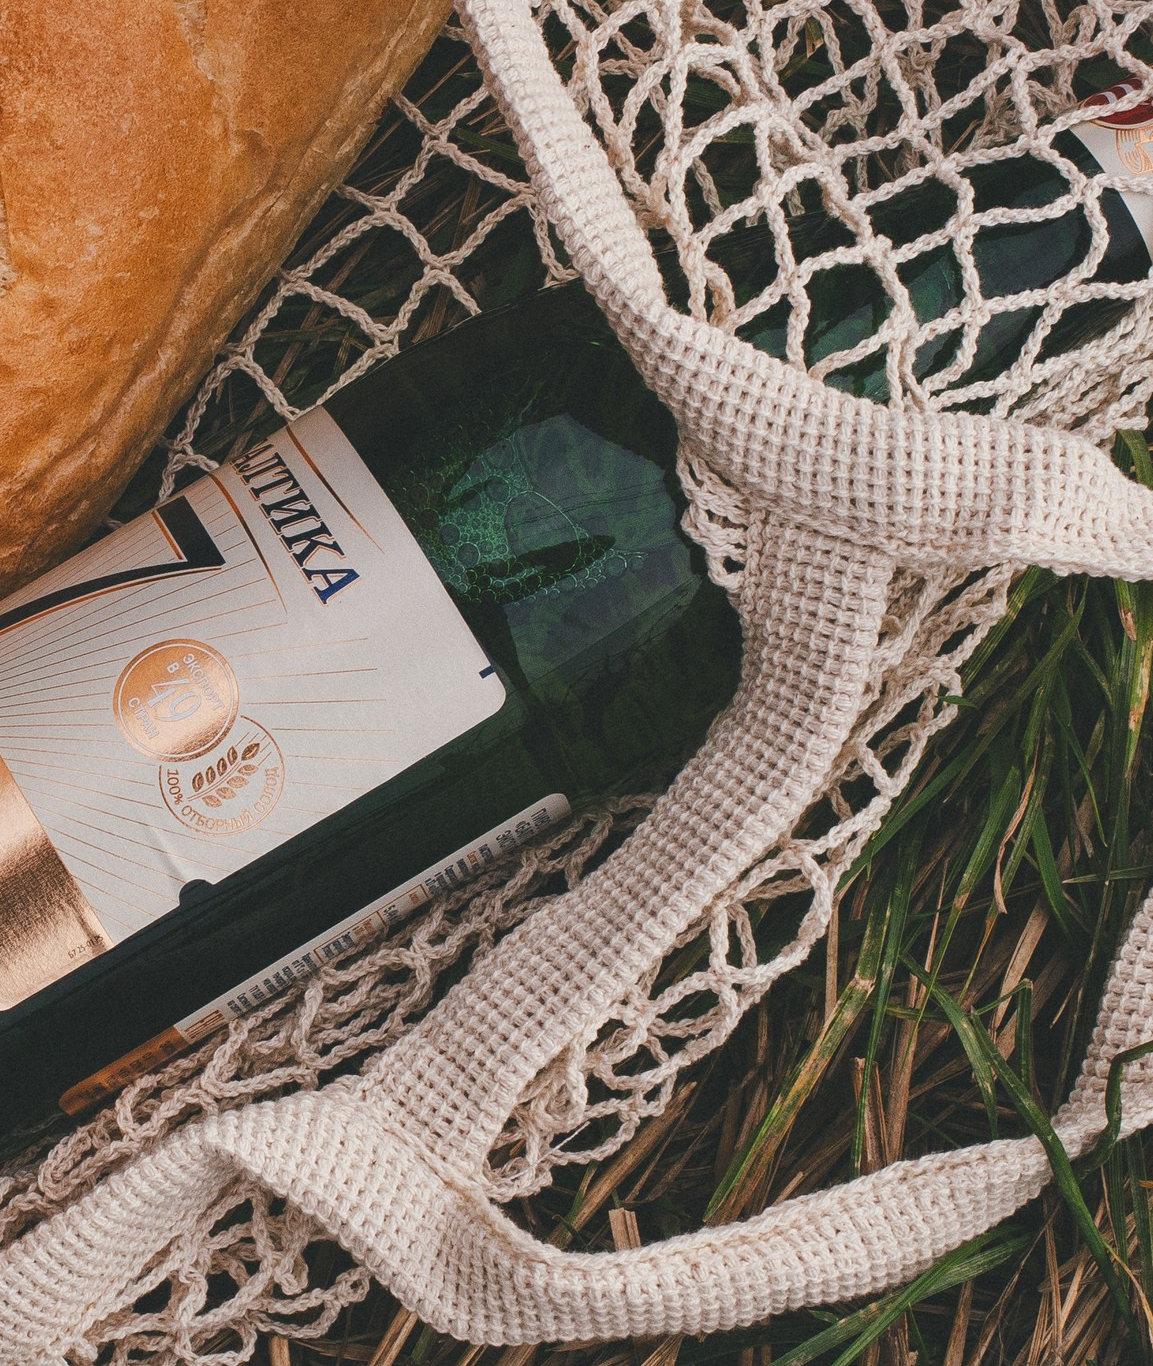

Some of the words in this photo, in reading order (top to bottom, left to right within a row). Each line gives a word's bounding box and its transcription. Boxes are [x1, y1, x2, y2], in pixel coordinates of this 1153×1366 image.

[167, 662, 180, 674] В
[183, 653, 225, 711] ЭКСПОРТ
[128, 697, 160, 740] СТРАН
[148, 678, 202, 724] 49
[167, 769, 184, 805] 100%
[181, 805, 254, 831] ОТБОРНЫЙ
[253, 766, 280, 814] СОЛОД
